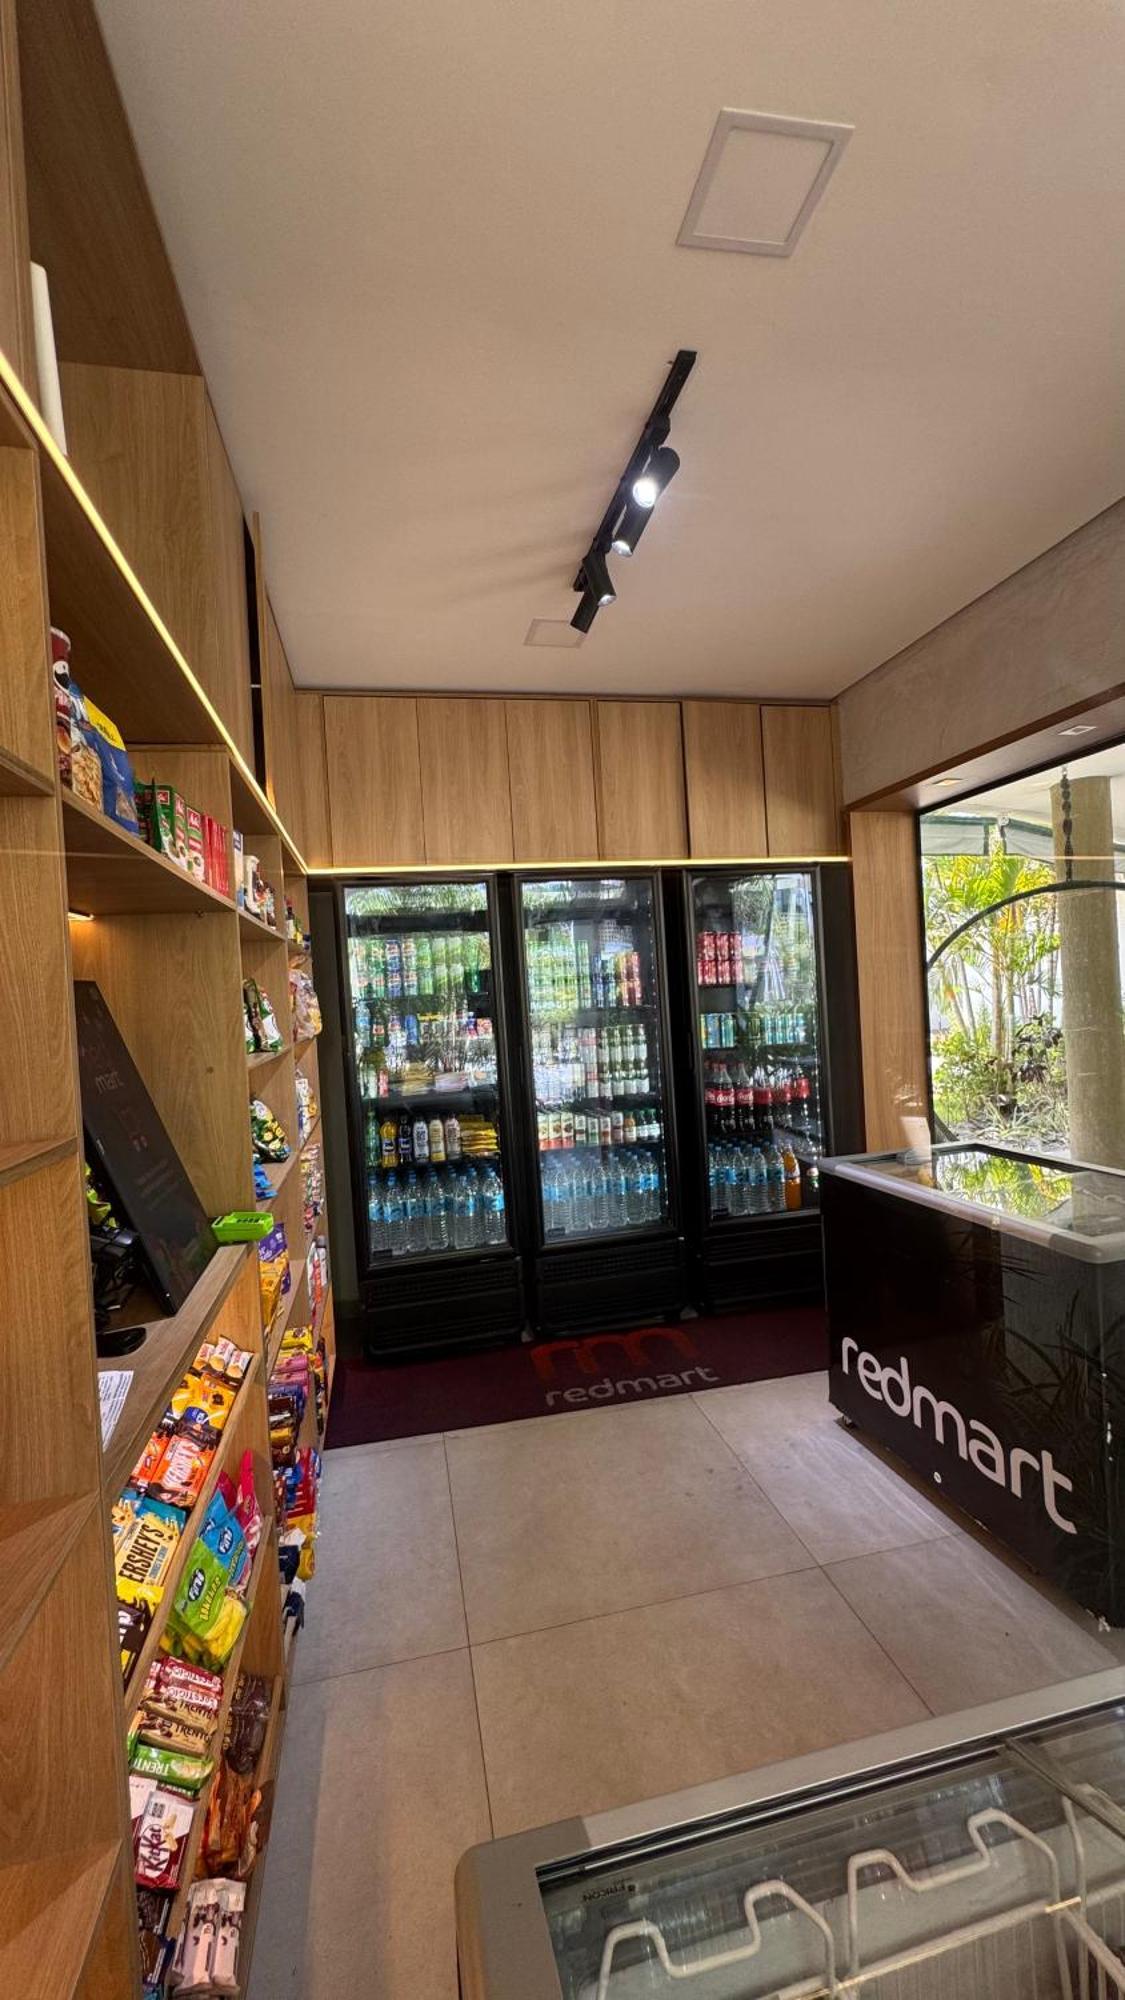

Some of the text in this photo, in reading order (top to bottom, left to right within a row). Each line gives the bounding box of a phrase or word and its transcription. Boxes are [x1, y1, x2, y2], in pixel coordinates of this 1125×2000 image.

[545, 1356, 720, 1407] redmart
[841, 1336, 1078, 1535] redmart
[119, 1525, 165, 1584] ERSHEY'S
[131, 1756, 170, 1777] TRENT
[140, 1825, 168, 1872] KitKat
